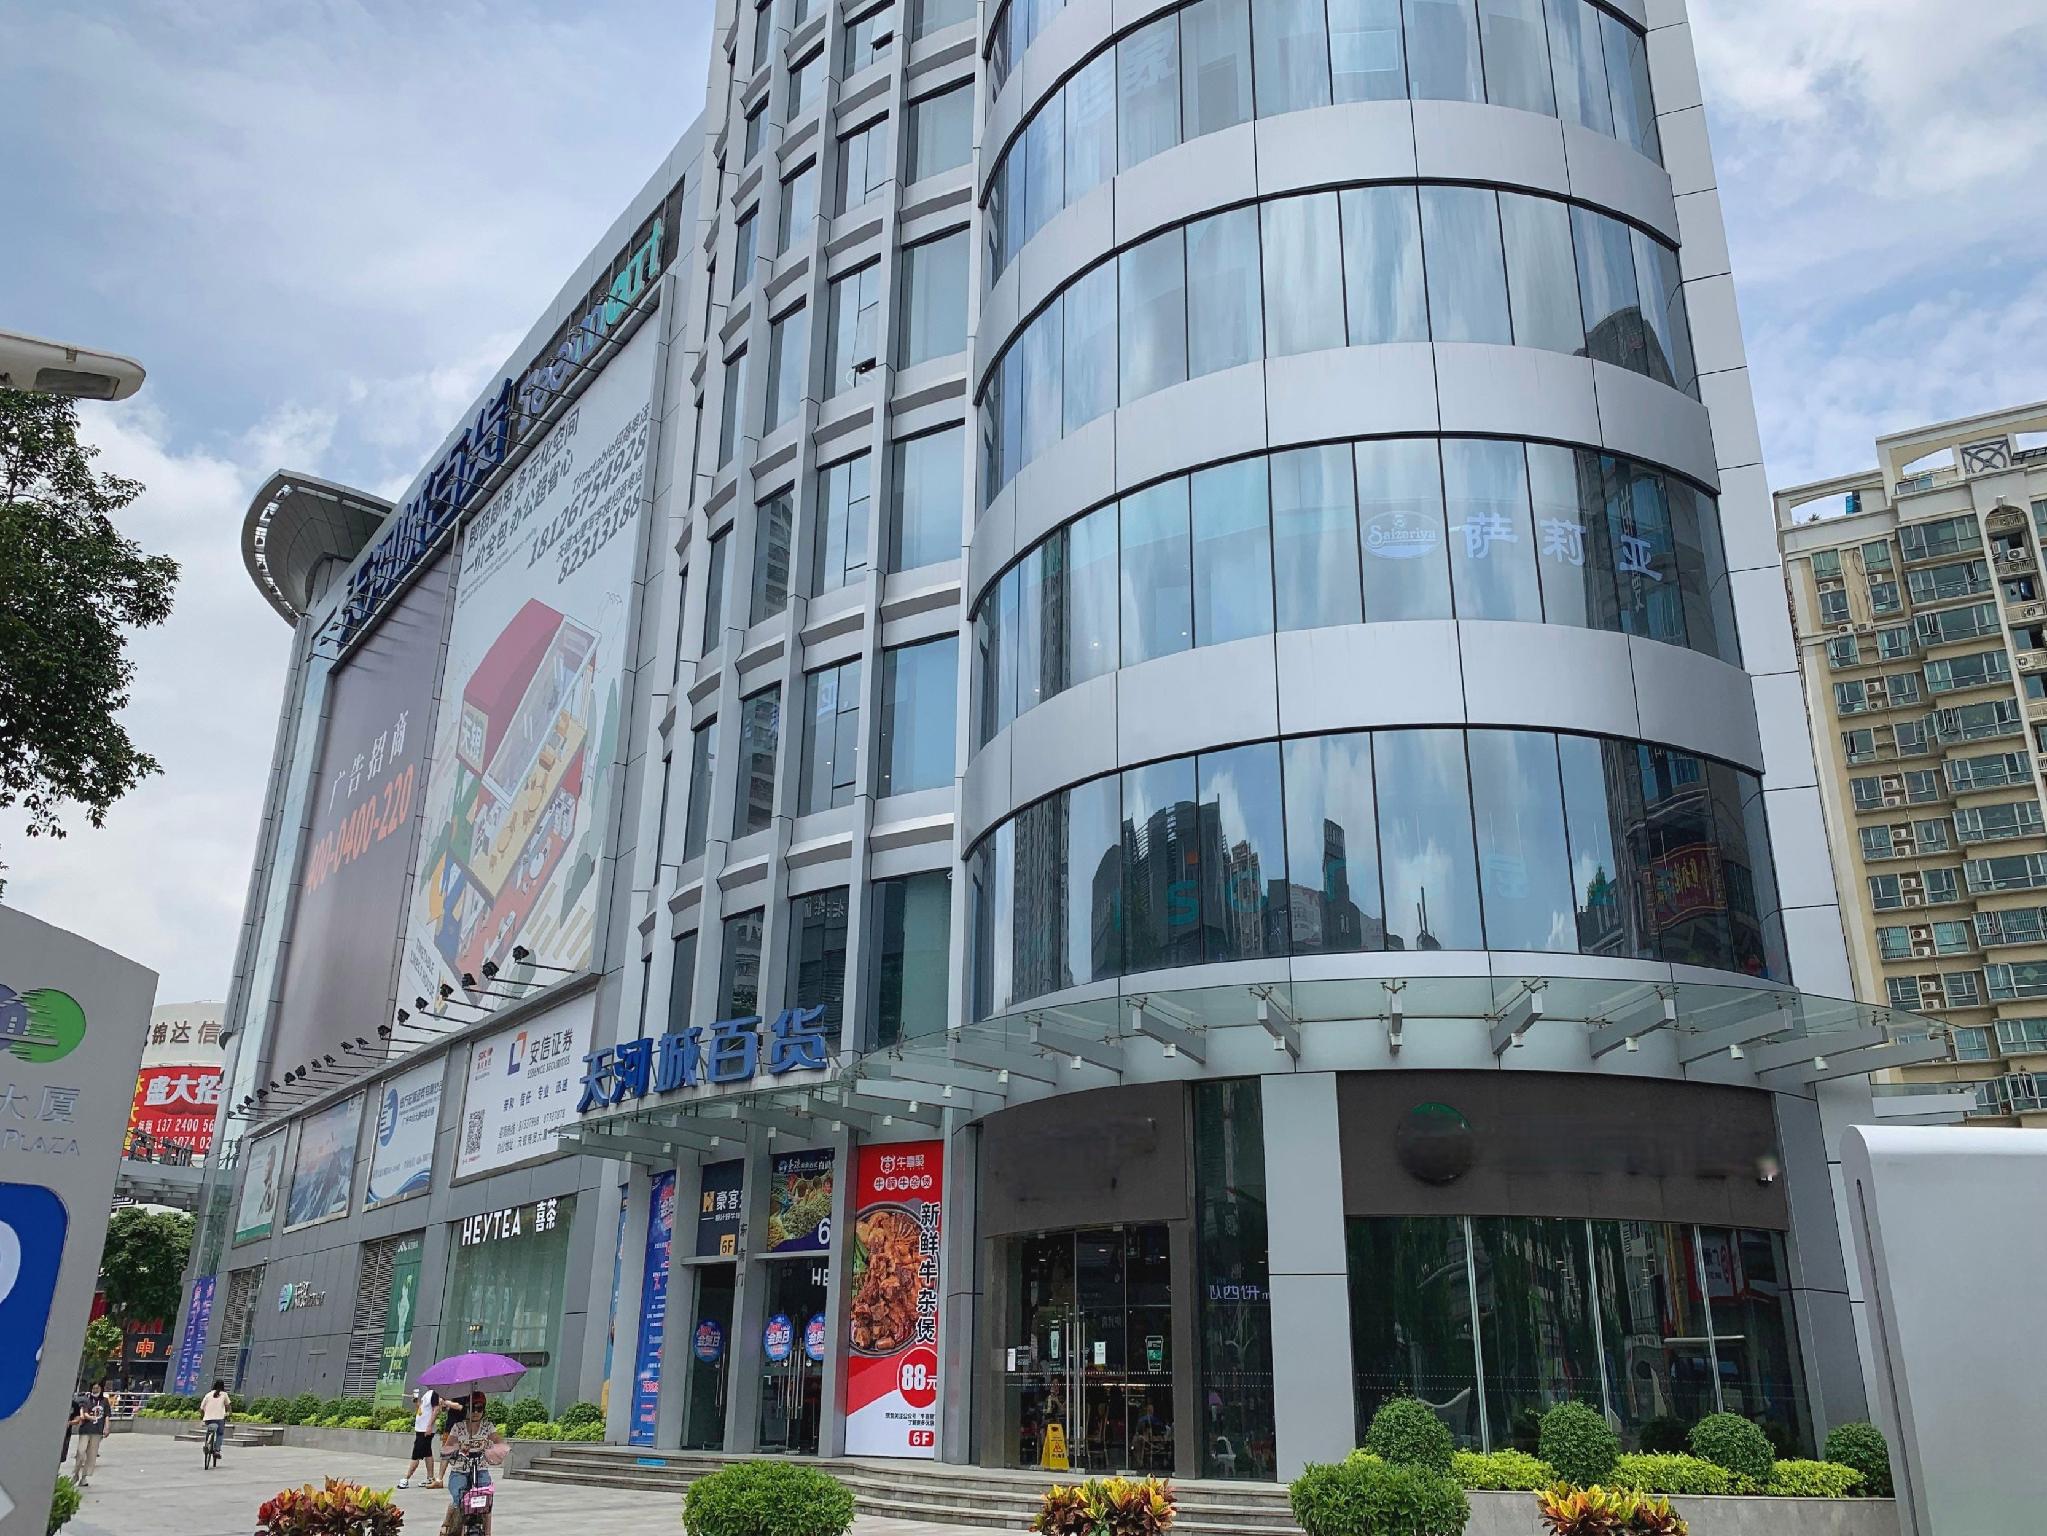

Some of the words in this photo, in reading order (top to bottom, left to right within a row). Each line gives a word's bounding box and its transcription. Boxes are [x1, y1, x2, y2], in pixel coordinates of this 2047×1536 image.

[515, 407, 580, 500] 多元化空间
[338, 378, 513, 652] 天河城百货
[464, 519, 508, 574] 一价全包
[509, 449, 573, 536] 办公超省心
[527, 425, 647, 570] 18126754928
[558, 485, 641, 584] 82313188
[1463, 511, 1663, 582] 萨莉亚
[328, 710, 408, 816] 广告招商
[144, 1020, 220, 1047] 锦达信
[529, 1028, 573, 1065] 安信证券
[577, 1003, 828, 1112] 天河城百货
[0, 1083, 81, 1123] 大厦
[144, 1074, 222, 1106] 盛大招
[3, 1129, 80, 1156] PLAZA
[157, 1119, 171, 1132] 137
[175, 1118, 198, 1132] 2400
[462, 1207, 521, 1246] HEYTEA
[721, 1239, 734, 1254] 6F
[915, 1201, 940, 1344] 新鲜牛杂煲
[902, 1364, 937, 1390] 88元
[913, 1432, 930, 1446] 6F
